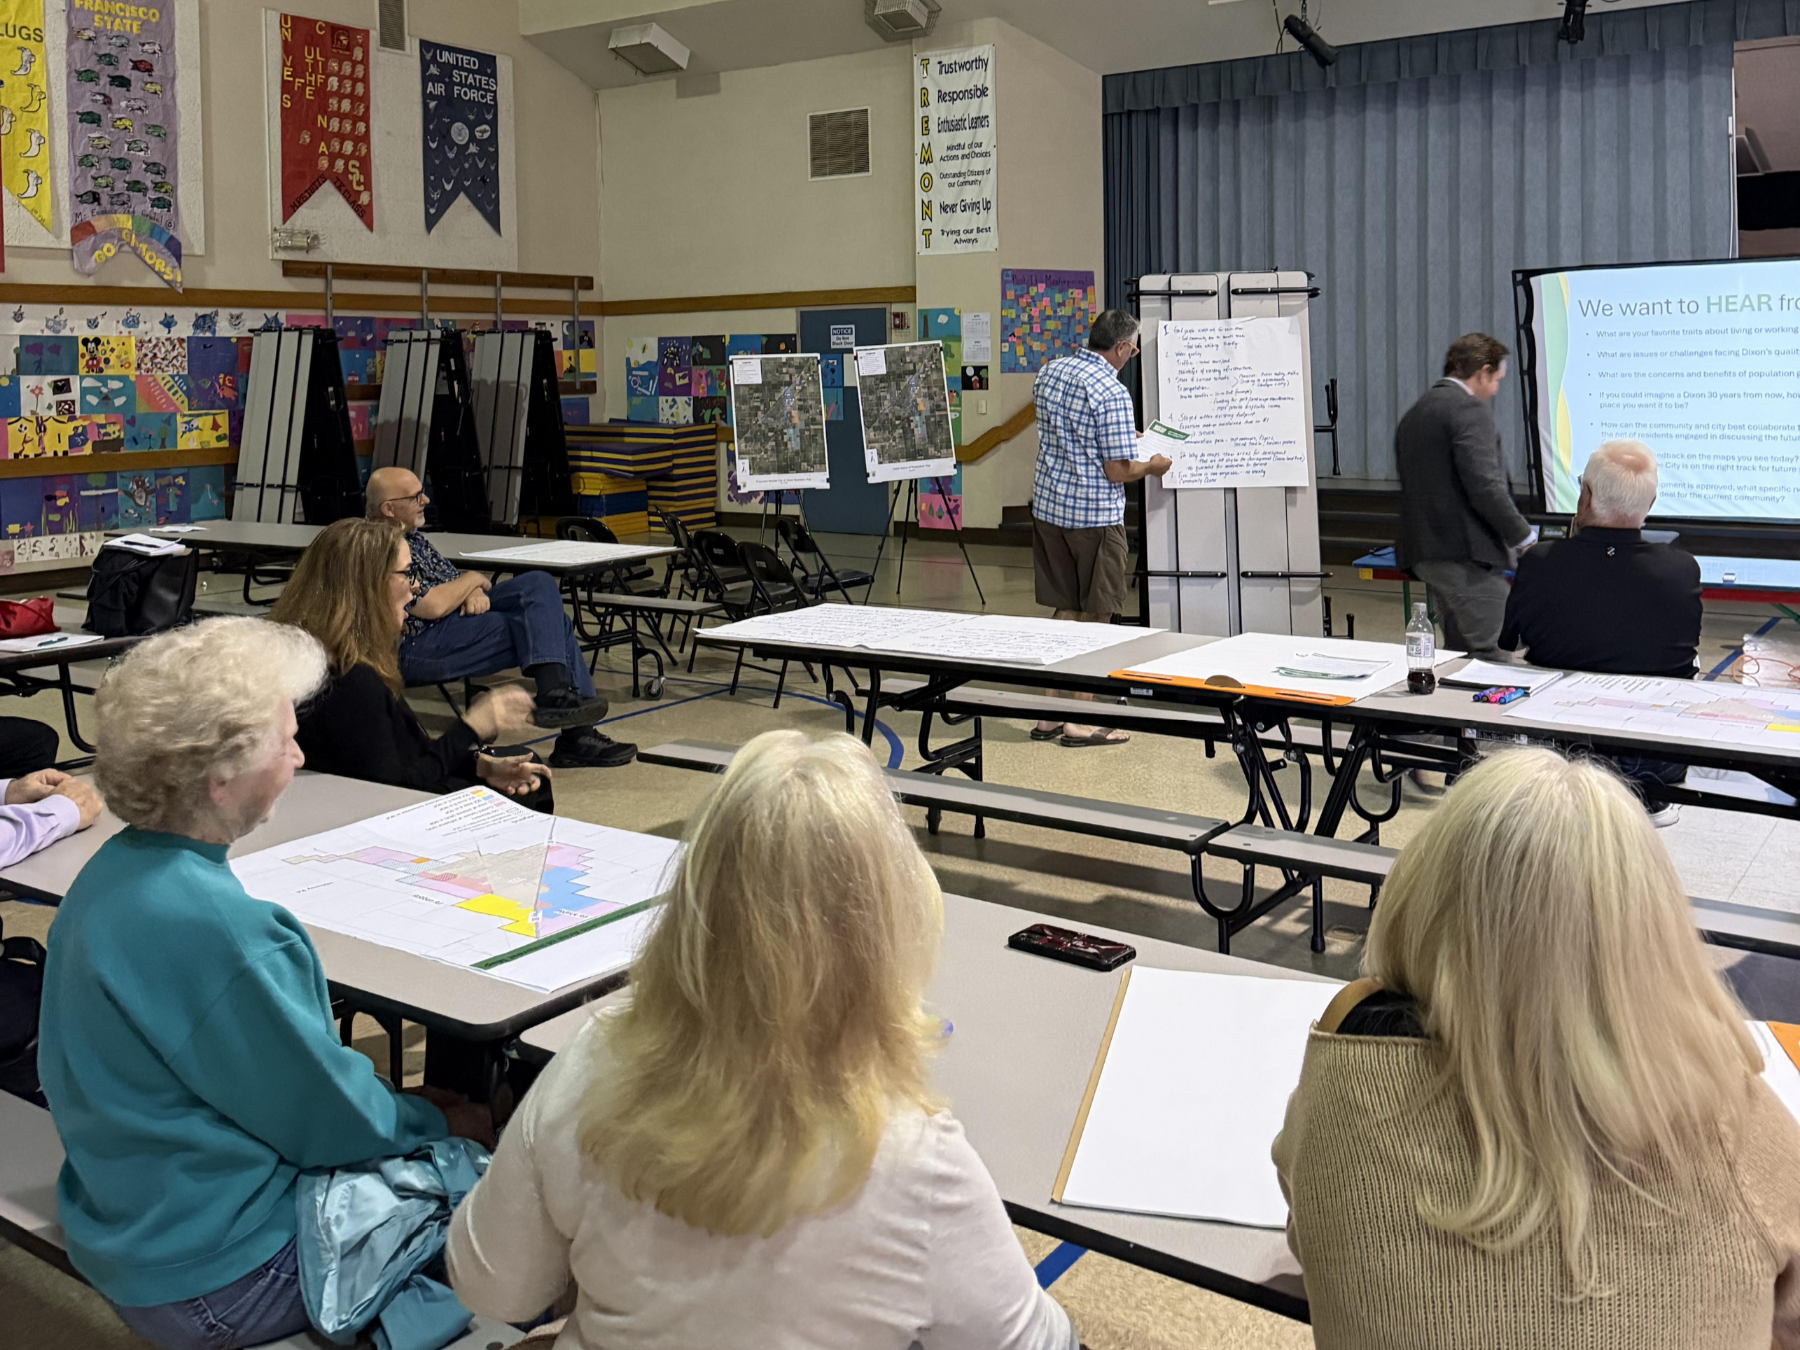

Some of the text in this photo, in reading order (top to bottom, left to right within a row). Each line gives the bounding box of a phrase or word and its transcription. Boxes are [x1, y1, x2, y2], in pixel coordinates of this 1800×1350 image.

[74, 0, 160, 23] FRANCISCO
[94, 14, 142, 34] STATE
[436, 49, 479, 70] UNITED
[937, 55, 989, 75] Trustworthy
[452, 69, 497, 91] STATES
[426, 81, 495, 105] AIR FORCE
[937, 84, 989, 105] Responsible
[937, 113, 989, 134] Enthusiastic Learners
[946, 142, 965, 152] Mindful
[974, 141, 983, 149] our
[939, 150, 991, 162] Actions and Choices
[940, 170, 966, 180] Outstanding
[967, 169, 985, 177] Citizens
[956, 179, 982, 188] Community
[940, 197, 992, 216] Never Giving Up
[940, 229, 960, 237] Trying
[976, 226, 992, 234] Best
[954, 237, 978, 245] Always
[93, 229, 182, 288] GO GATORS!
[1578, 299, 1614, 318] We
[1618, 299, 1672, 317] want
[1678, 297, 1700, 315] to
[1706, 294, 1773, 314] HEAR
[1596, 330, 1617, 338] What
[1651, 329, 1680, 337] favorite
[1682, 328, 1703, 336] traits
[1705, 327, 1729, 335] about
[1730, 327, 1753, 335] living
[1764, 326, 1799, 334] working
[1669, 350, 1713, 358] challenges
[1714, 349, 1740, 357] facing
[1741, 348, 1773, 356] Dixon's
[1703, 370, 1737, 378] benefits
[1748, 370, 1795, 379] population
[1605, 392, 1620, 400] you
[1644, 391, 1675, 400] imagine
[1719, 392, 1741, 400] years
[1764, 392, 1785, 400] now,
[1600, 401, 1621, 409] place
[1622, 402, 1636, 410] you
[1649, 422, 1693, 430] community
[1711, 423, 1726, 431] city
[1675, 433, 1709, 441] engaged
[1719, 433, 1763, 442] discussing
[1713, 454, 1736, 462] maps
[1737, 455, 1752, 463] you
[1770, 455, 1799, 464] today?
[1665, 461, 1681, 470] City
[1716, 464, 1734, 472] right
[1758, 464, 1770, 472] for
[1771, 465, 1797, 473] future
[1695, 483, 1735, 492] approved,
[1758, 485, 1792, 493] specific
[1703, 493, 1732, 501] current
[1734, 494, 1786, 504] community?
